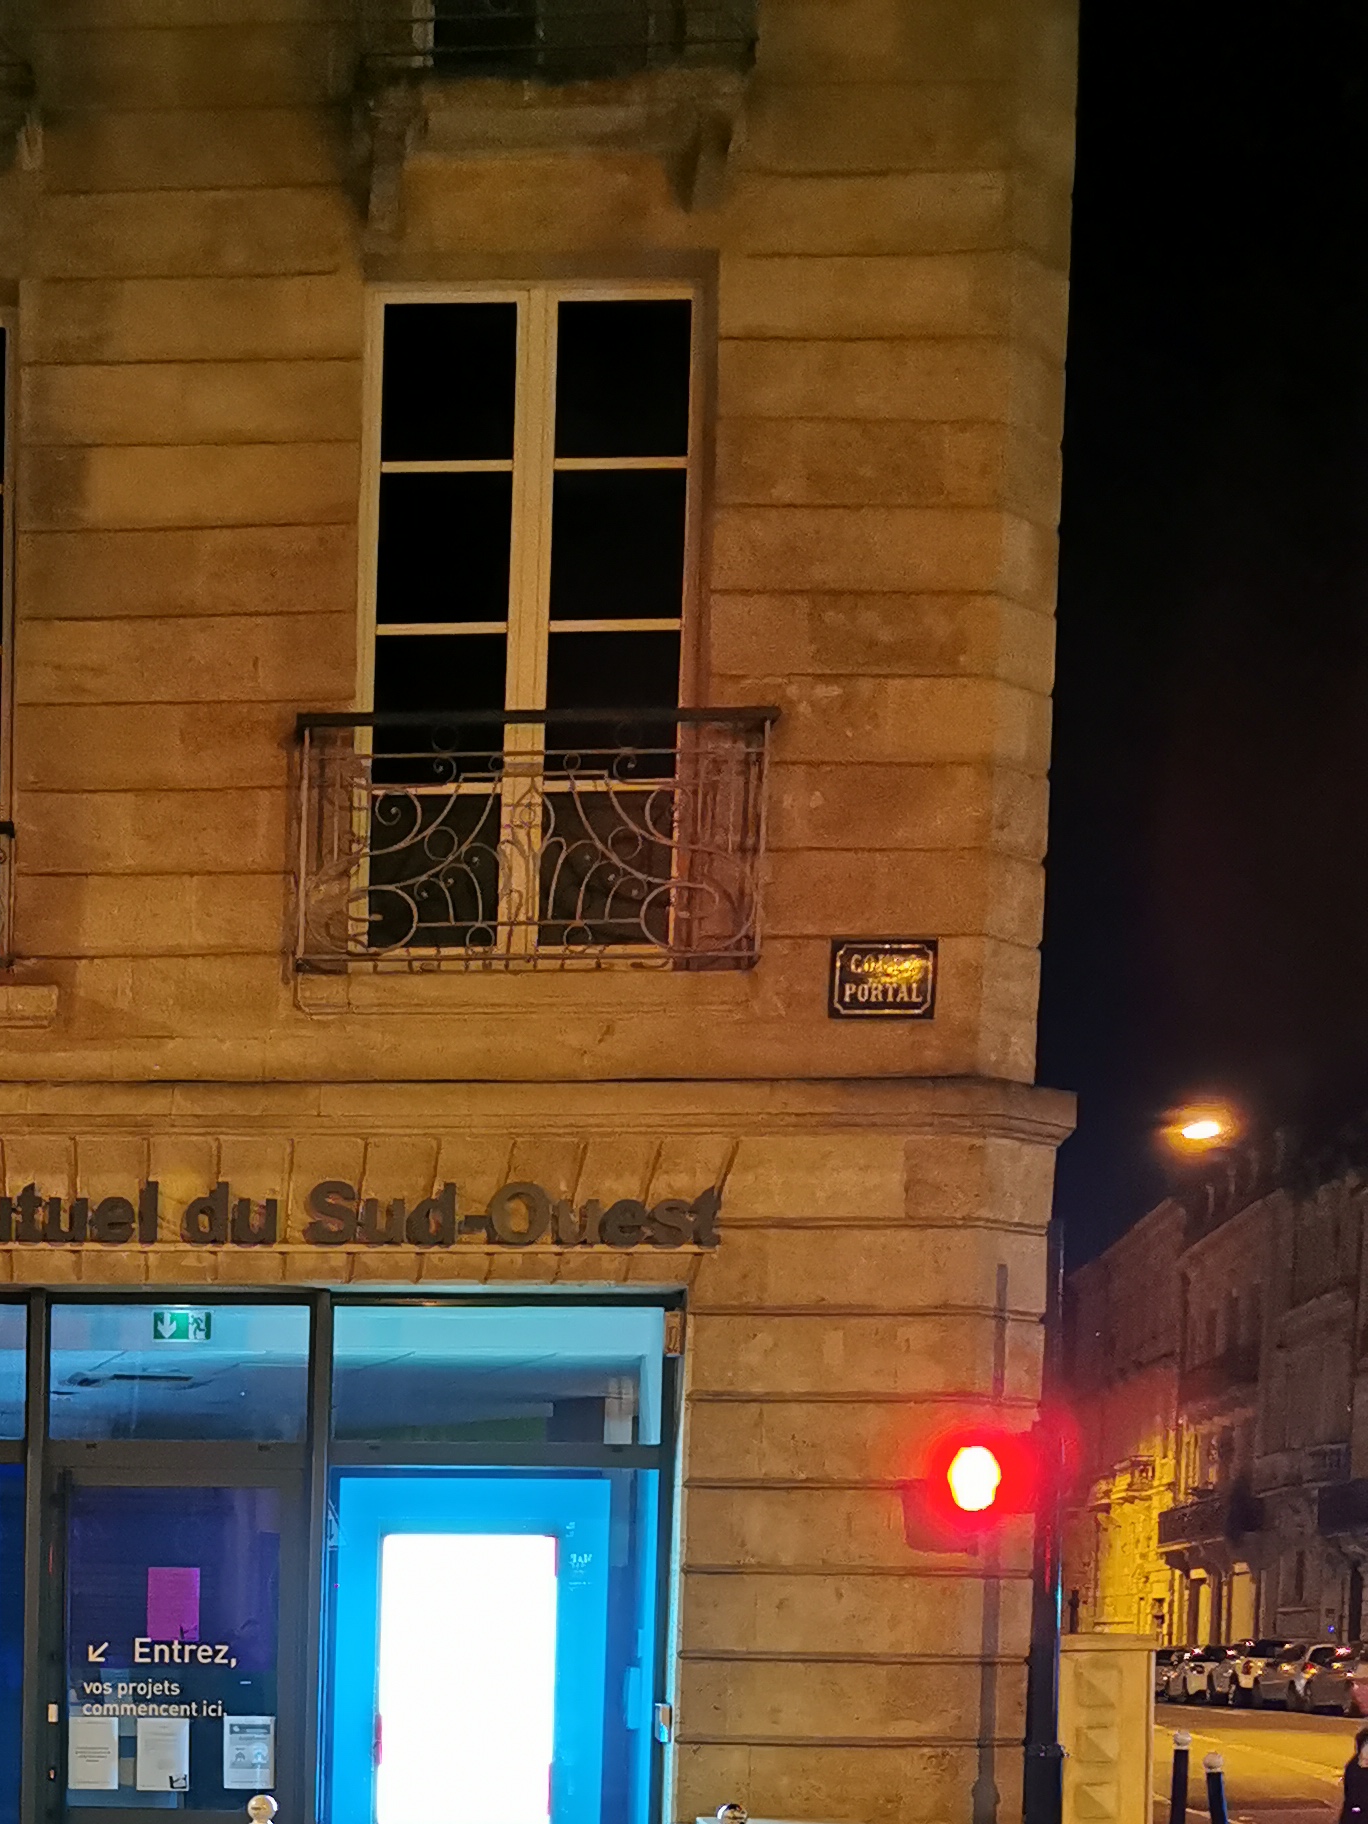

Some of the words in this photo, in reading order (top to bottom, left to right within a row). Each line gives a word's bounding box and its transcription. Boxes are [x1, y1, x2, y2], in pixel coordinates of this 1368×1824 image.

[843, 981, 923, 1003] PORTAL
[183, 1181, 278, 1247] du
[304, 1180, 722, 1249] Sud-Ouest
[134, 1637, 237, 1668] Entrez,
[83, 1681, 113, 1695] vos
[117, 1679, 181, 1699] projets
[82, 1701, 199, 1717] commencent
